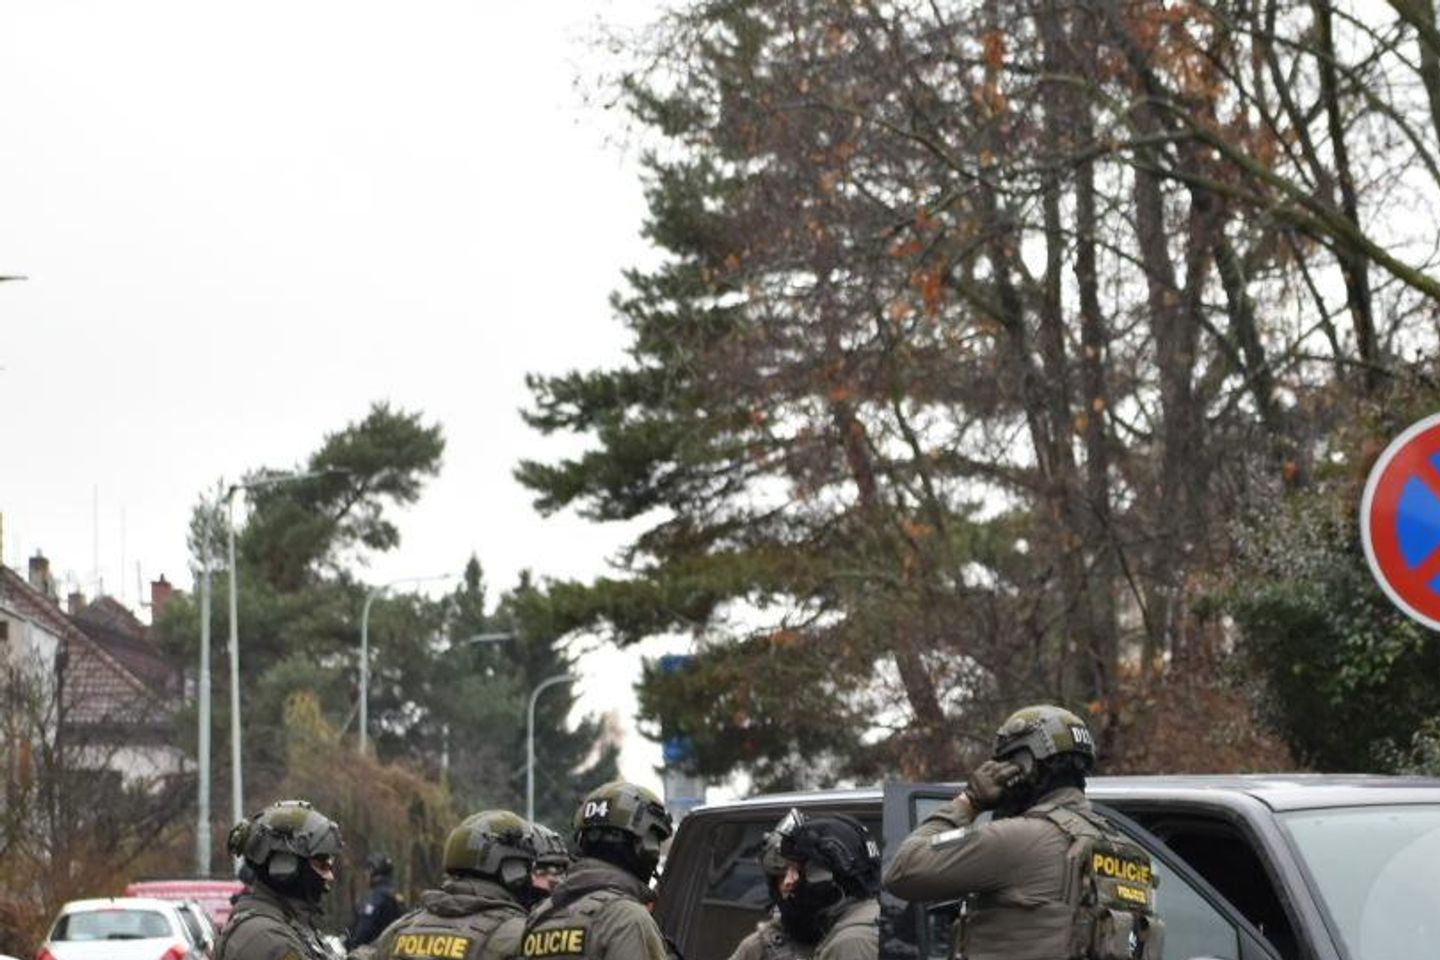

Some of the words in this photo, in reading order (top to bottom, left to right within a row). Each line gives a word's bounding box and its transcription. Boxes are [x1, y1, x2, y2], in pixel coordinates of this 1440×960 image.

[584, 801, 608, 818] D4
[1093, 853, 1150, 884] POLICIE
[395, 934, 468, 959] POLICIE
[524, 929, 584, 957] OLICIE
